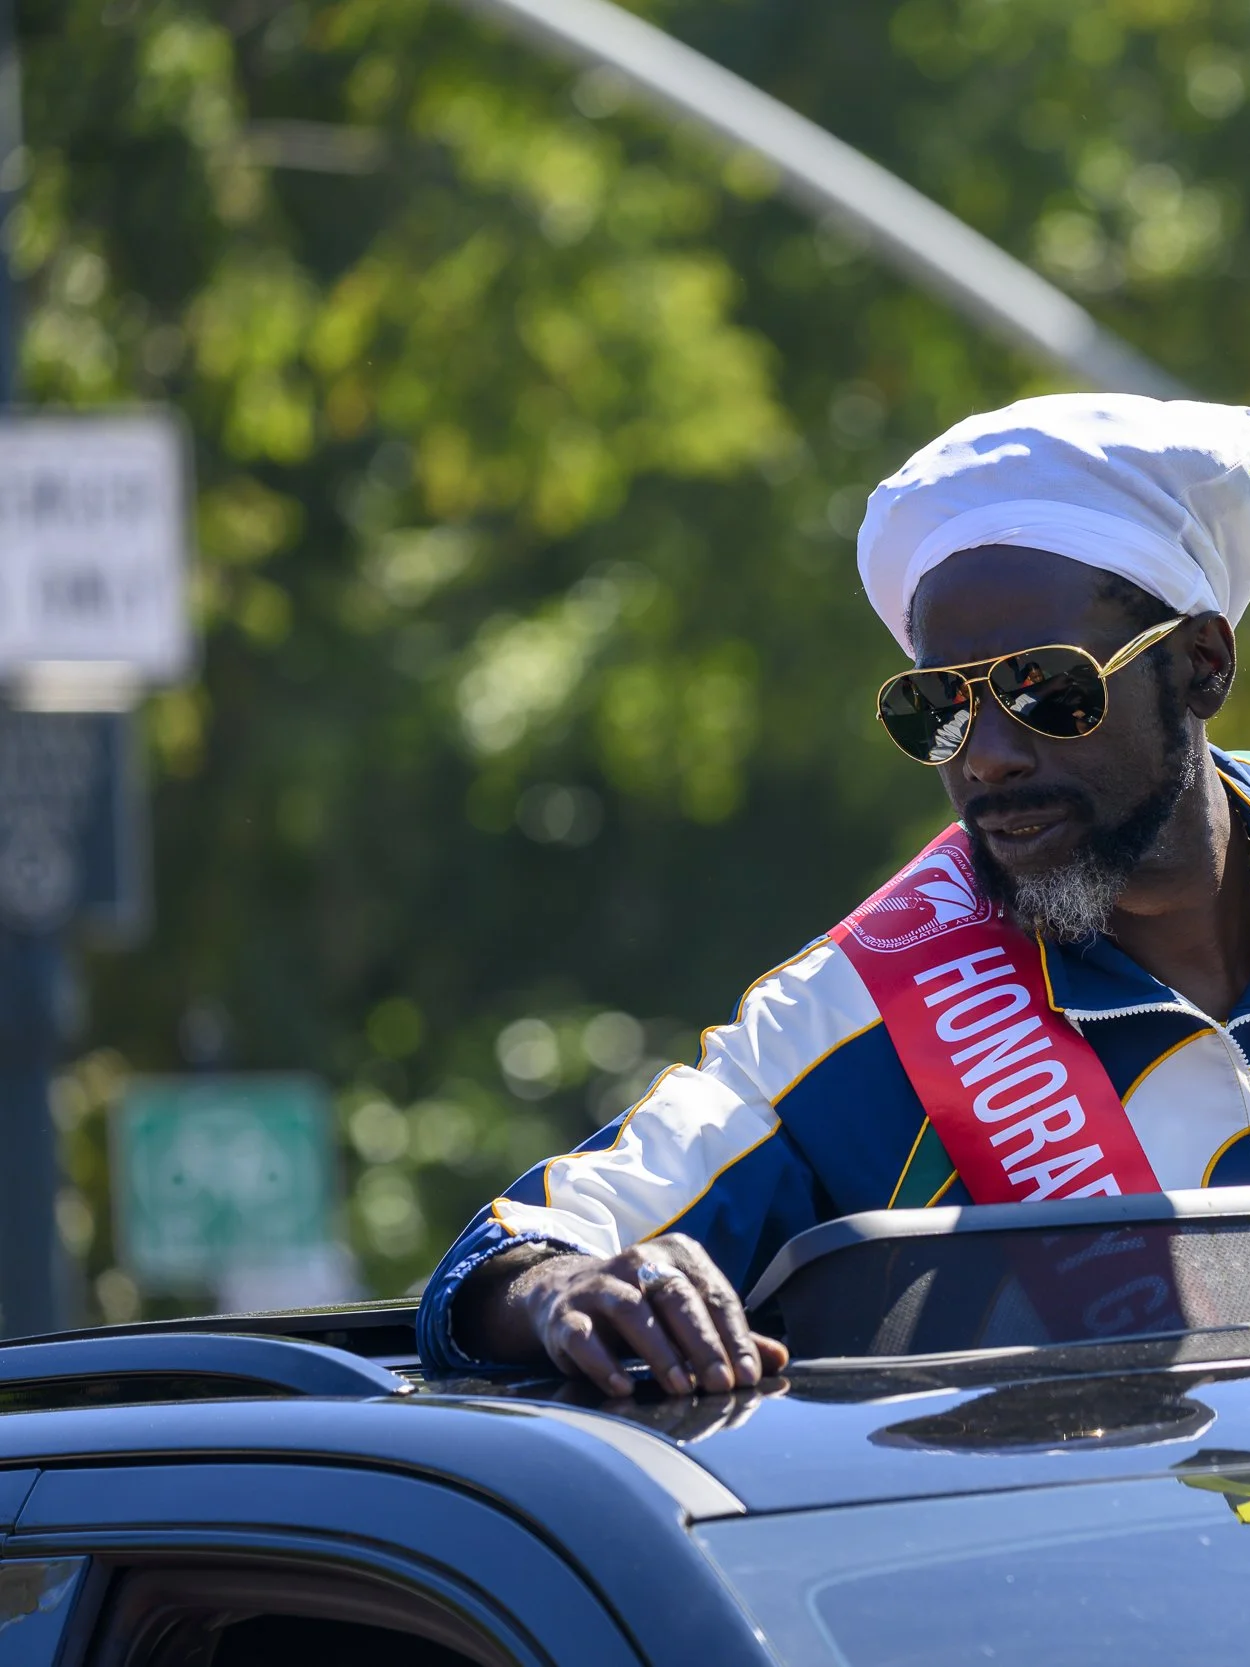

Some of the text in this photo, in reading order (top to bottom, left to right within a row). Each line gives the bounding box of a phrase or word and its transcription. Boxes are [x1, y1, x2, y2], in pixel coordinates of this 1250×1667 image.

[941, 848, 967, 870] INDIAN
[965, 871, 985, 917] AMEAN
[956, 914, 978, 925] DAY
[862, 923, 948, 949] INCORPORATED
